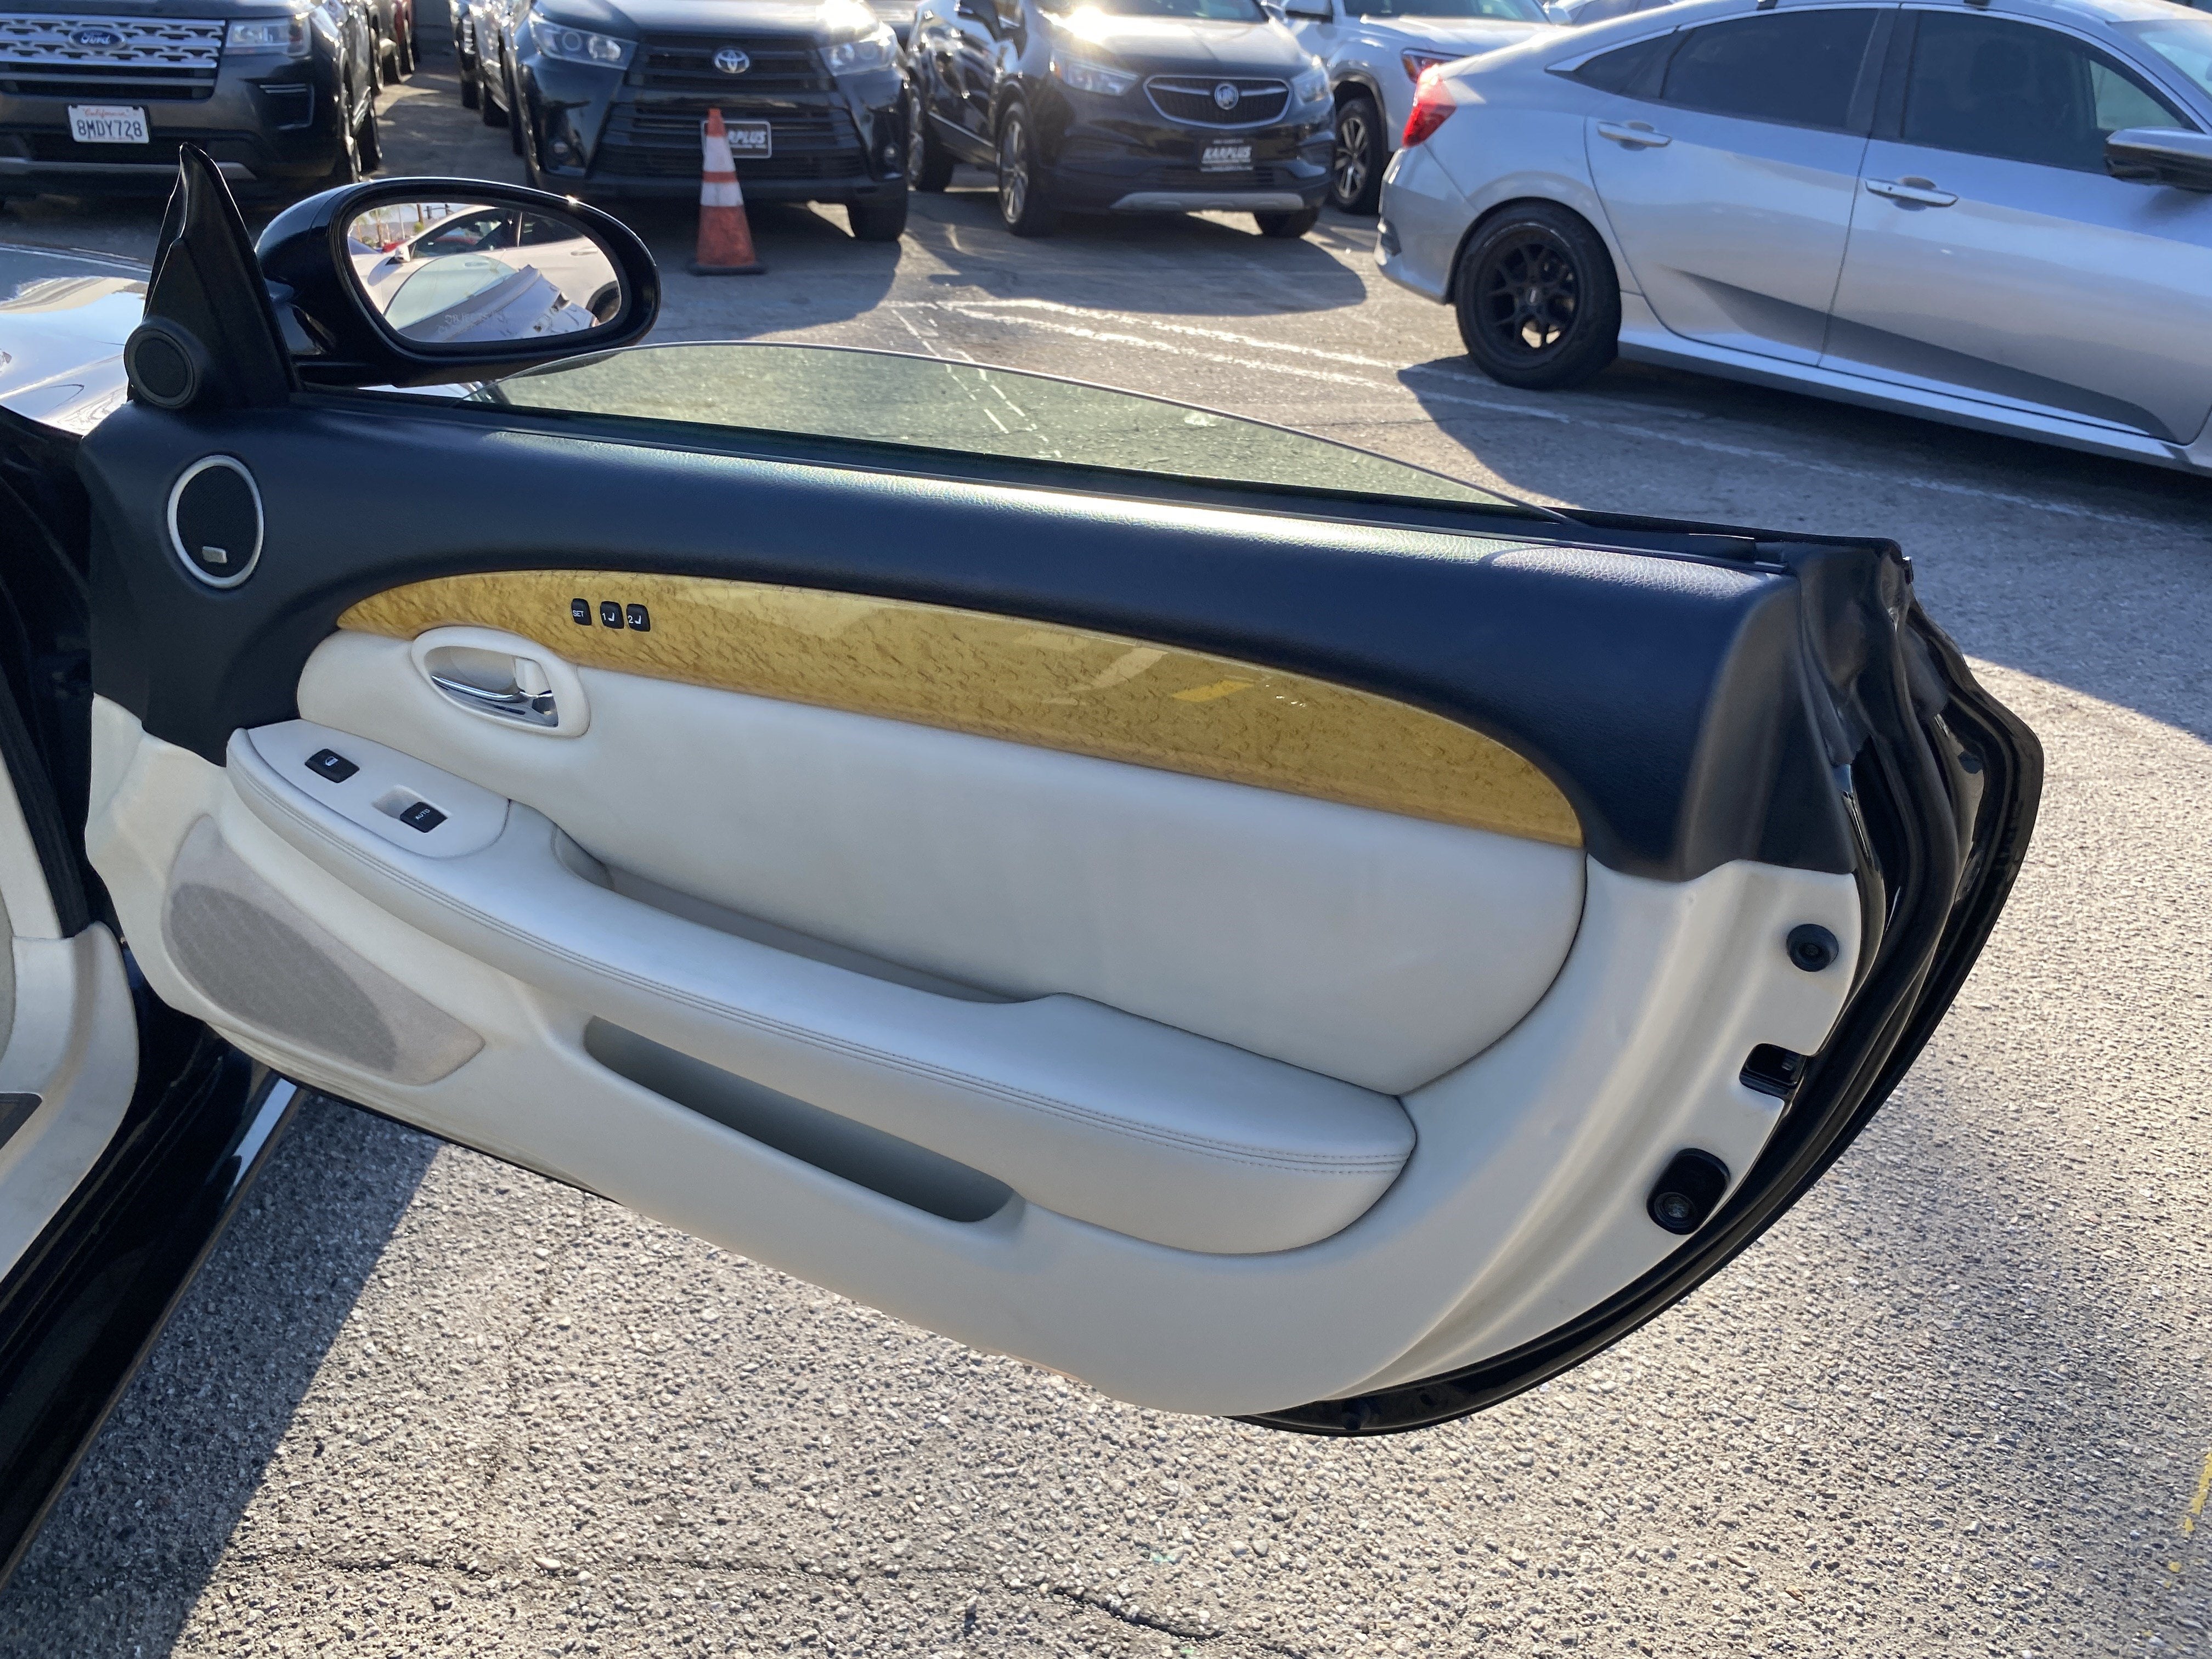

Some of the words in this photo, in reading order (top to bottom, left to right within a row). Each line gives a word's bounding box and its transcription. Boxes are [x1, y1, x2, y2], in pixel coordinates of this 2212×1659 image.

[81, 33, 110, 44] Ford
[77, 119, 143, 138] 8MDY728
[602, 612, 607, 621] 1
[628, 615, 634, 624] 2
[415, 809, 430, 821] AUTO
